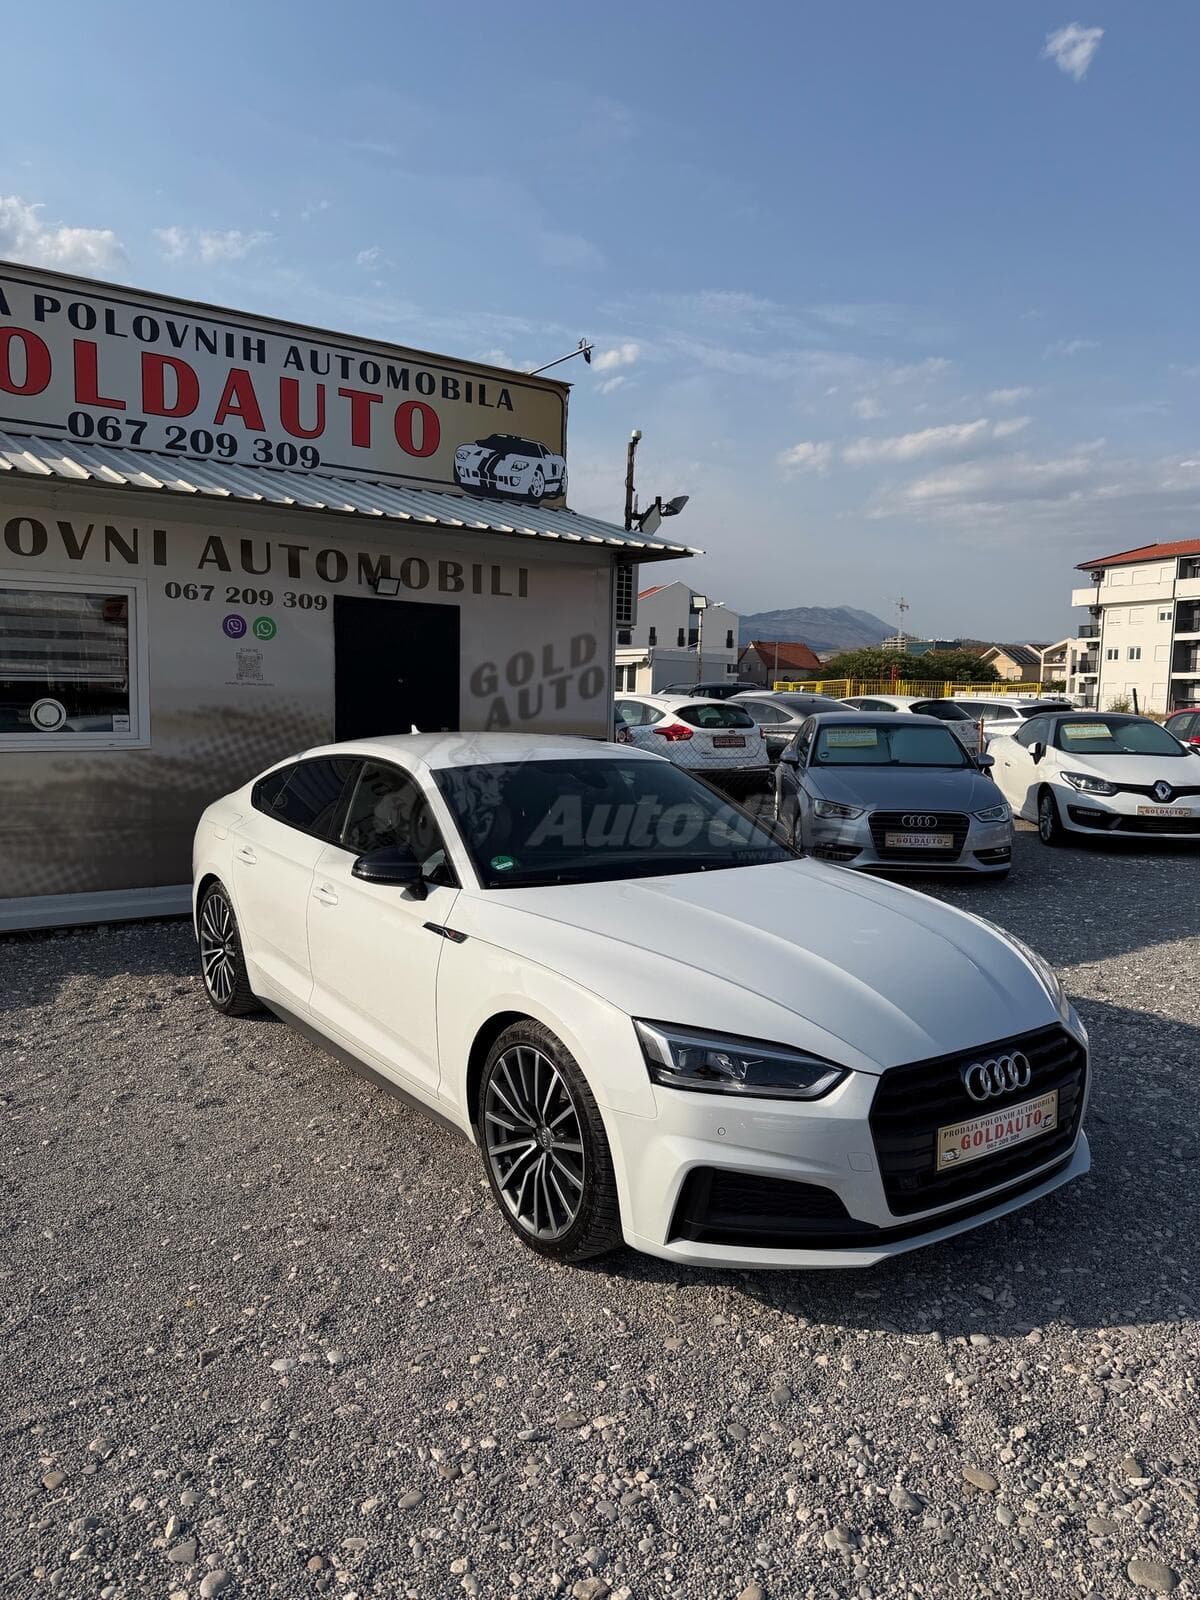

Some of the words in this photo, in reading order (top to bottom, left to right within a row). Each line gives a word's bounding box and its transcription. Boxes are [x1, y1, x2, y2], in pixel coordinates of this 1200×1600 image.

[34, 293, 266, 364] POLOVNIH
[283, 345, 514, 412] AUTOMOBILA
[0, 325, 441, 458] OLDAUTO
[67, 411, 148, 445] 067
[165, 425, 238, 458] 209
[253, 438, 321, 469] 309
[4, 516, 167, 566] OVNI
[197, 535, 529, 598] AUTOMOBILI
[164, 581, 215, 602] 067
[225, 586, 274, 606] 209
[283, 592, 328, 611] 309
[469, 633, 597, 698] GOLD
[484, 666, 605, 732] AUTO
[896, 837, 943, 845] GOLDAUTO
[943, 1122, 979, 1139] PRODAJA
[980, 1111, 1015, 1128] POLOVNIH
[1016, 1096, 1055, 1117] AUTOMOBILA
[960, 1109, 1042, 1150] GOLDAUTO
